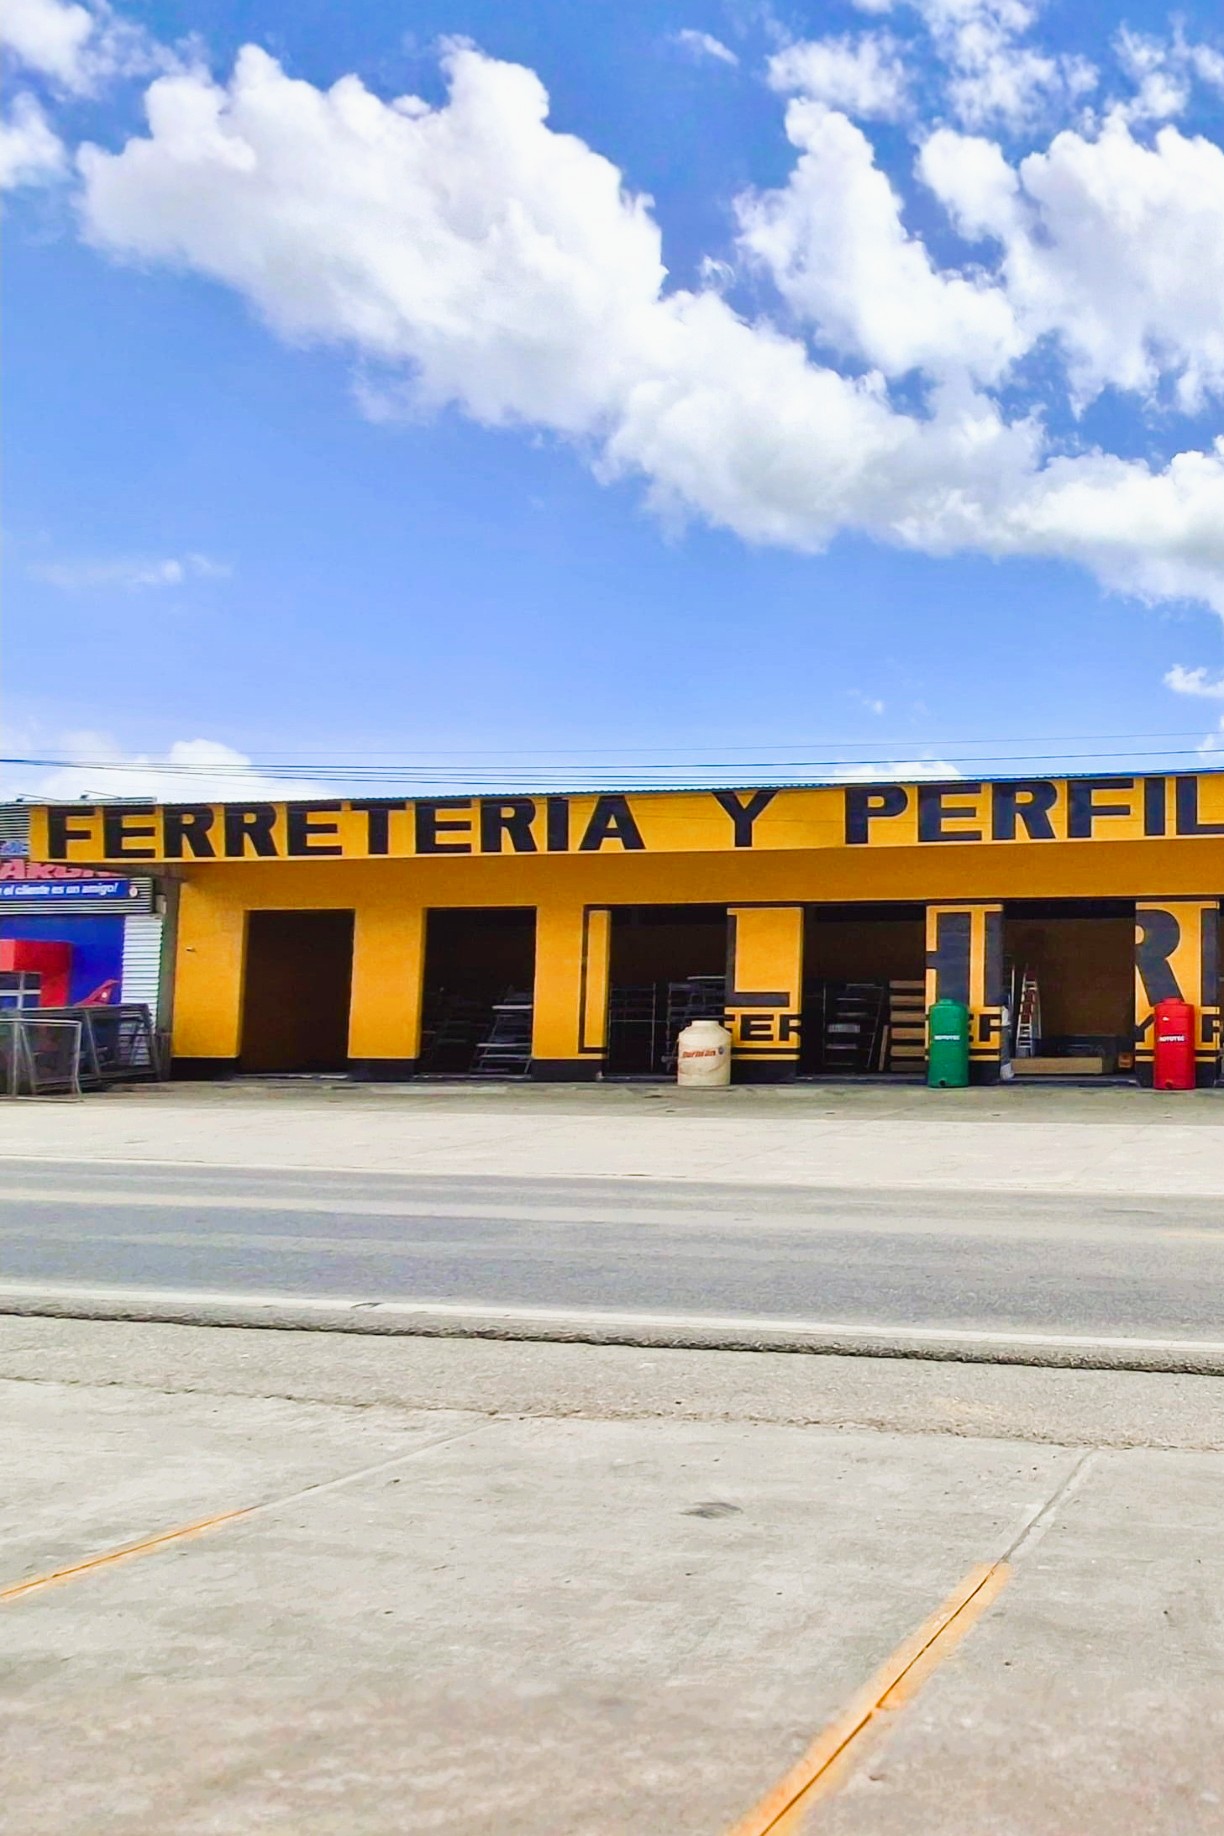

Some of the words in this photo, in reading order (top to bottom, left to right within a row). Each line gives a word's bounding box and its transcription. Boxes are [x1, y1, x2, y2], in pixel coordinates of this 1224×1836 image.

[48, 795, 646, 859] FERRETERIA
[712, 788, 782, 848] Y
[3, 885, 14, 895] el
[15, 884, 50, 895] cliente
[51, 885, 65, 894] es
[82, 882, 119, 896] amigo!
